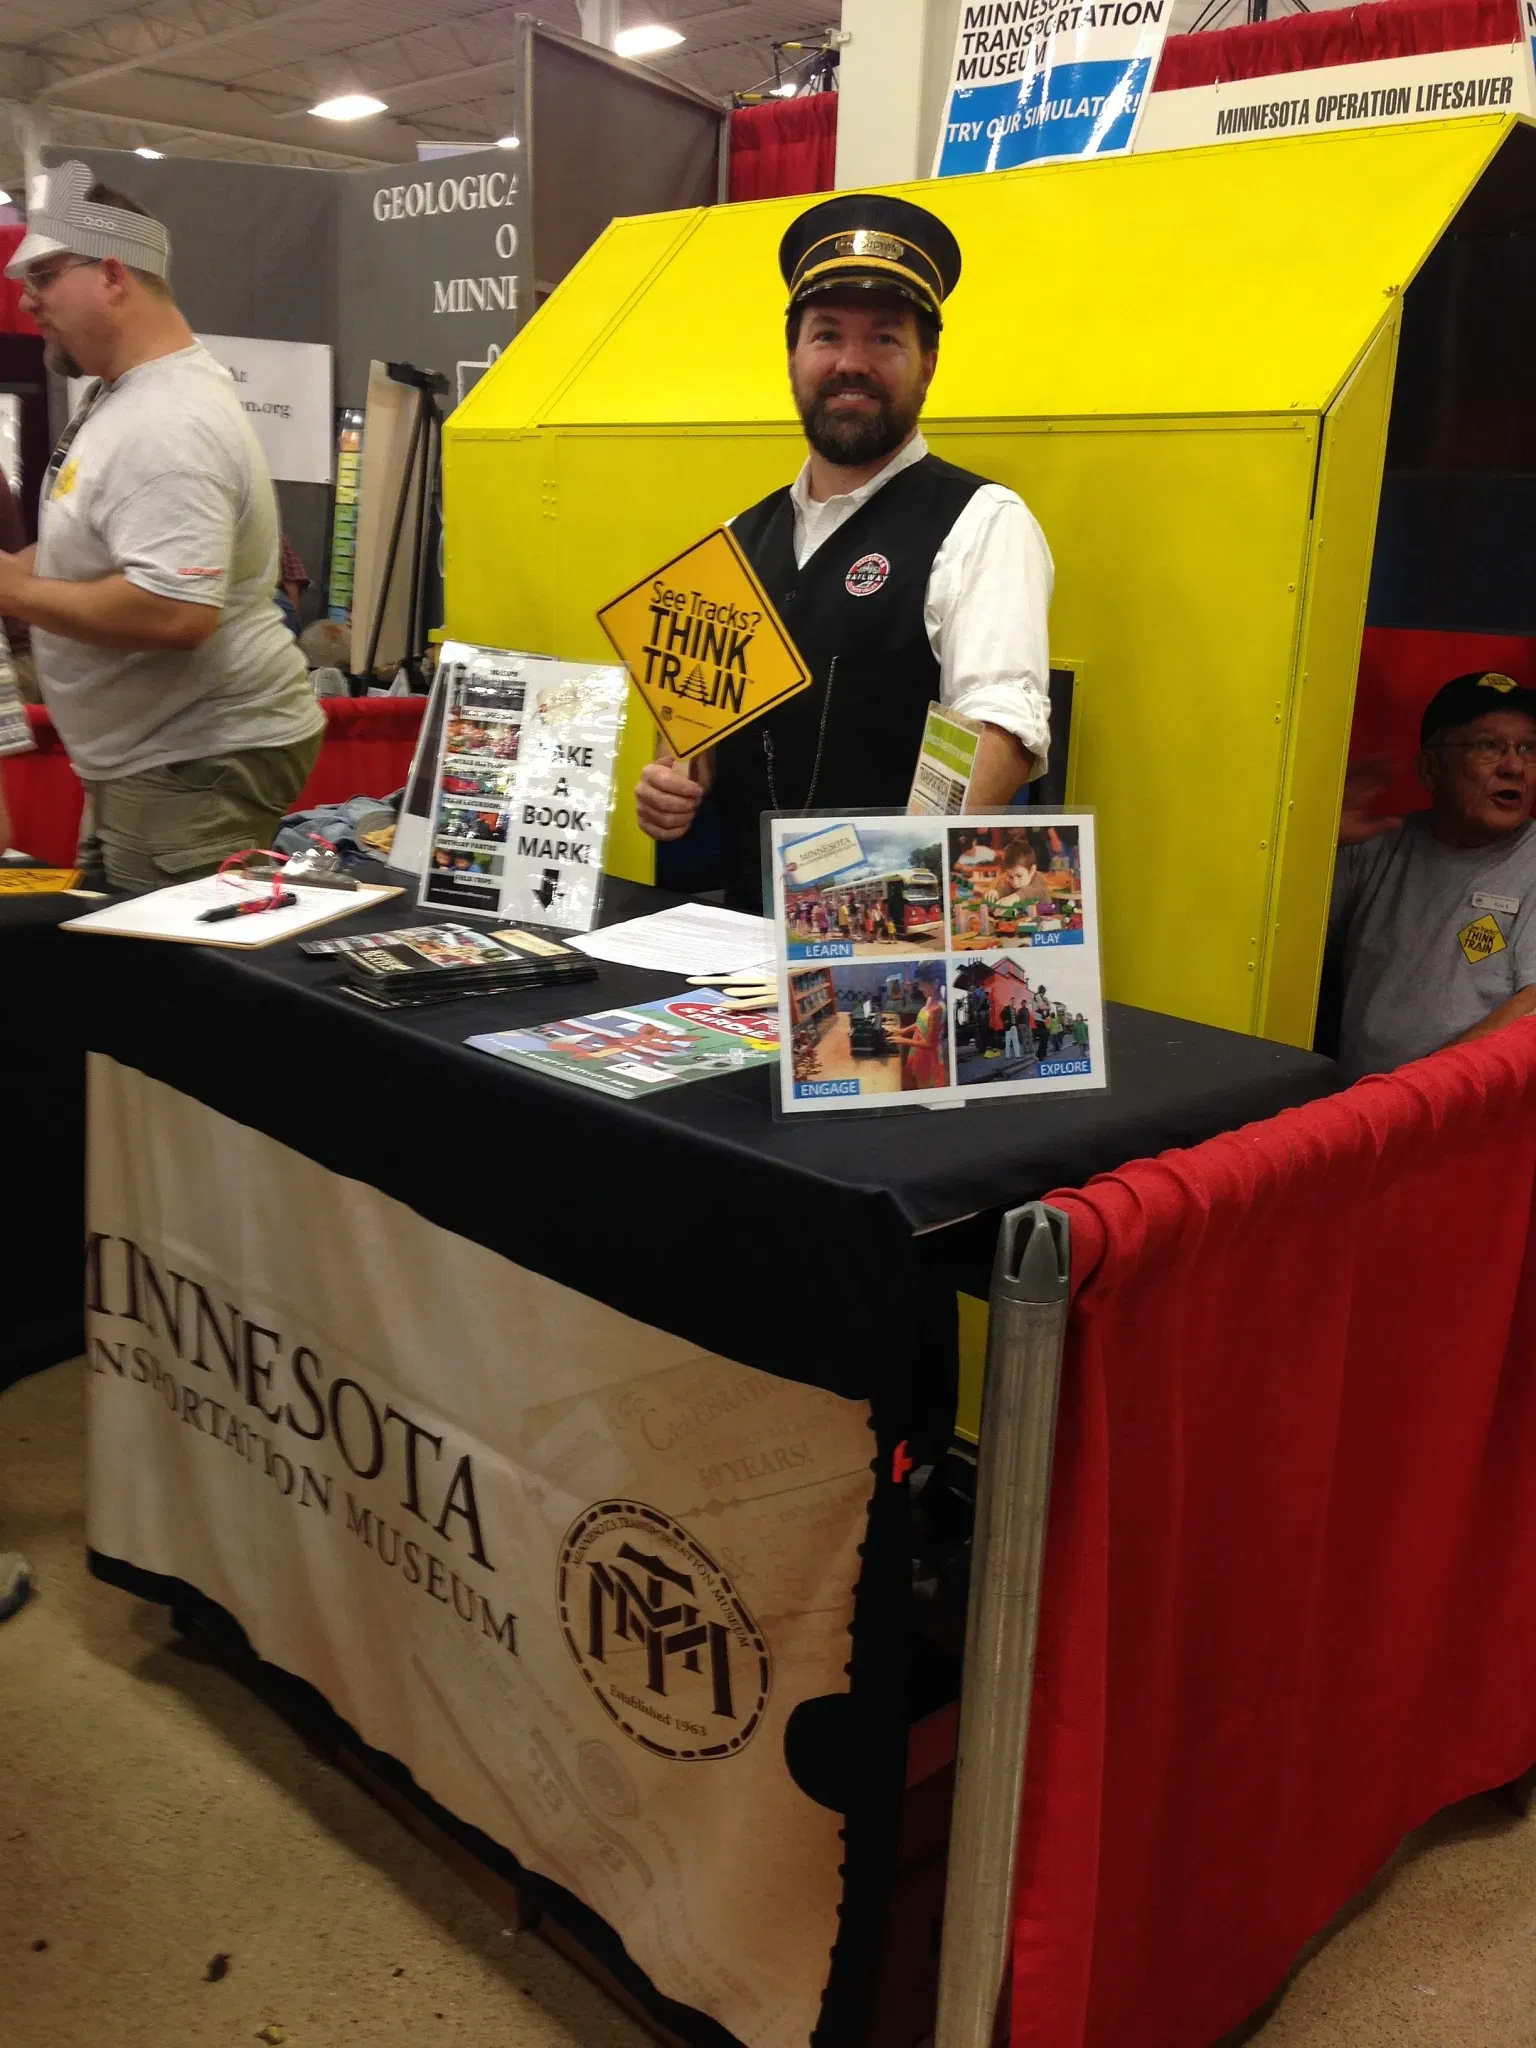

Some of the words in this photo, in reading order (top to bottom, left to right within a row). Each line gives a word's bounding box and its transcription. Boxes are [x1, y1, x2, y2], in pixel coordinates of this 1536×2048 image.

[962, 1, 1163, 55] TRANSPORTATION
[956, 41, 1048, 81] MUSEUM
[1216, 99, 1309, 135] MINNESOTA
[1315, 86, 1411, 123] OPERATION
[1416, 76, 1513, 112] LIFESAVER
[948, 121, 984, 143] TRY
[987, 111, 1021, 139] OUR
[495, 223, 518, 259] O
[845, 573, 889, 582] RAILWAY
[650, 580, 687, 612] See
[691, 590, 762, 633] Tracks?
[648, 603, 755, 676] THINK
[552, 776, 569, 797] A
[799, 837, 852, 860] MINNESOTA
[805, 944, 850, 957] LEARN
[1034, 932, 1061, 945] PLAY
[1467, 929, 1495, 945] THINK
[1040, 1060, 1088, 1076] EXPLORE
[800, 1081, 858, 1097] ENGAGE
[722, 1439, 817, 1483] YEARS!
[344, 1491, 519, 1658] MUSEUM
[711, 1589, 750, 1648] MUSEUM
[609, 1683, 673, 1726] Established
[675, 1718, 708, 1737] 1963
